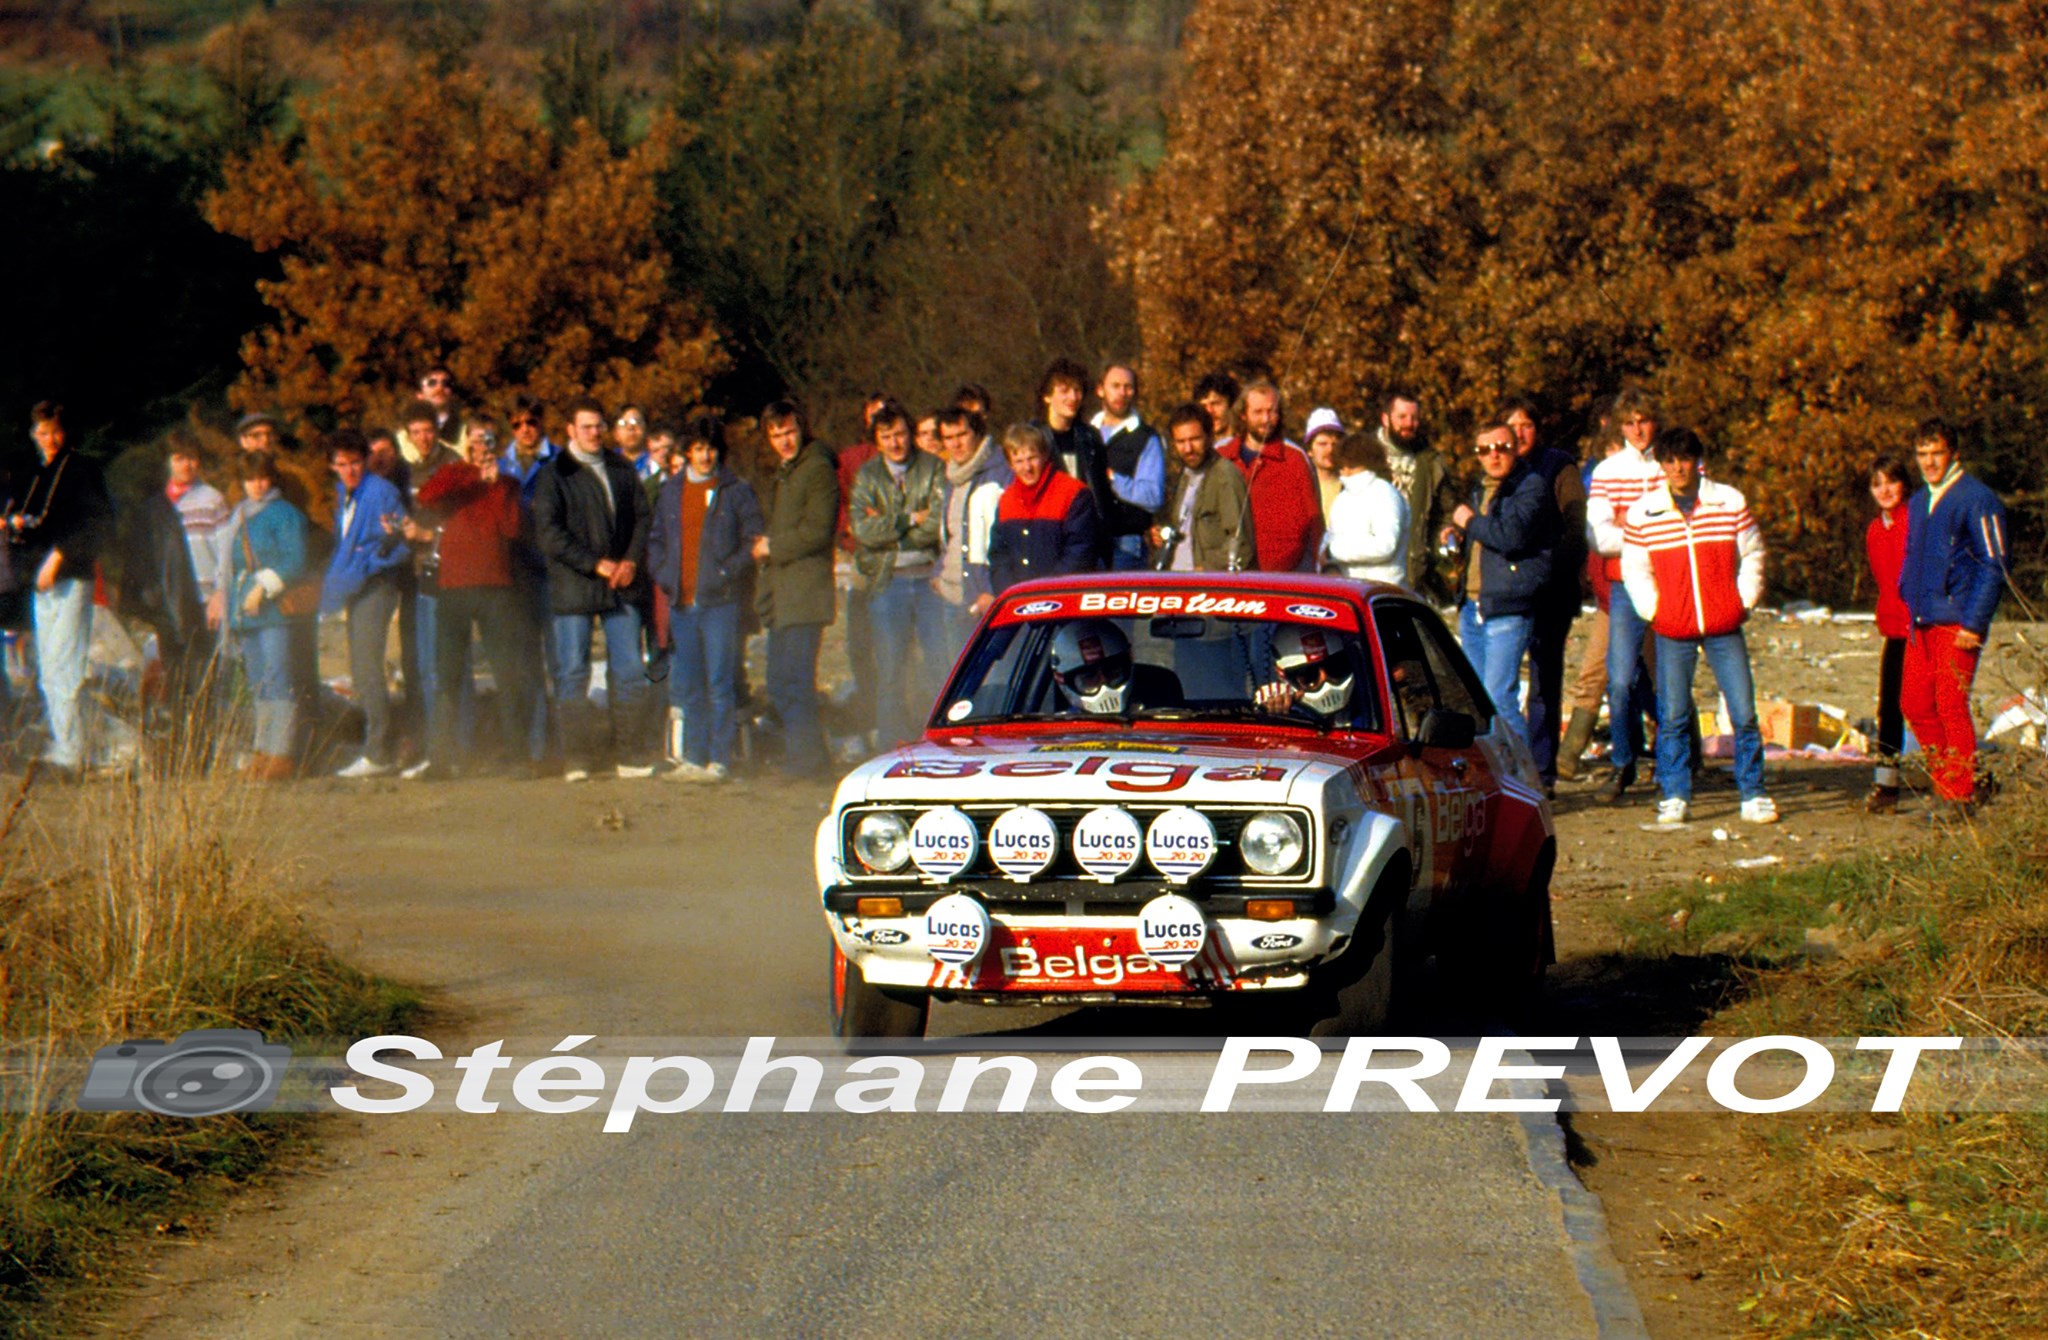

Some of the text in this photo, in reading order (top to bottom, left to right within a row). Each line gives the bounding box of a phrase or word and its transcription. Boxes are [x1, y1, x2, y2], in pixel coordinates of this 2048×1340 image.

[1080, 592, 1268, 615] Belga team
[883, 756, 1289, 793] Belga
[915, 828, 970, 849] Lucas
[994, 828, 1051, 849] Lucas
[1079, 828, 1136, 849] Lucas
[1152, 828, 1209, 849] Lucas
[927, 916, 980, 938] Lucas
[1144, 919, 1202, 939] Lucas
[1259, 934, 1294, 948] Ford
[1000, 945, 1158, 985] Belga
